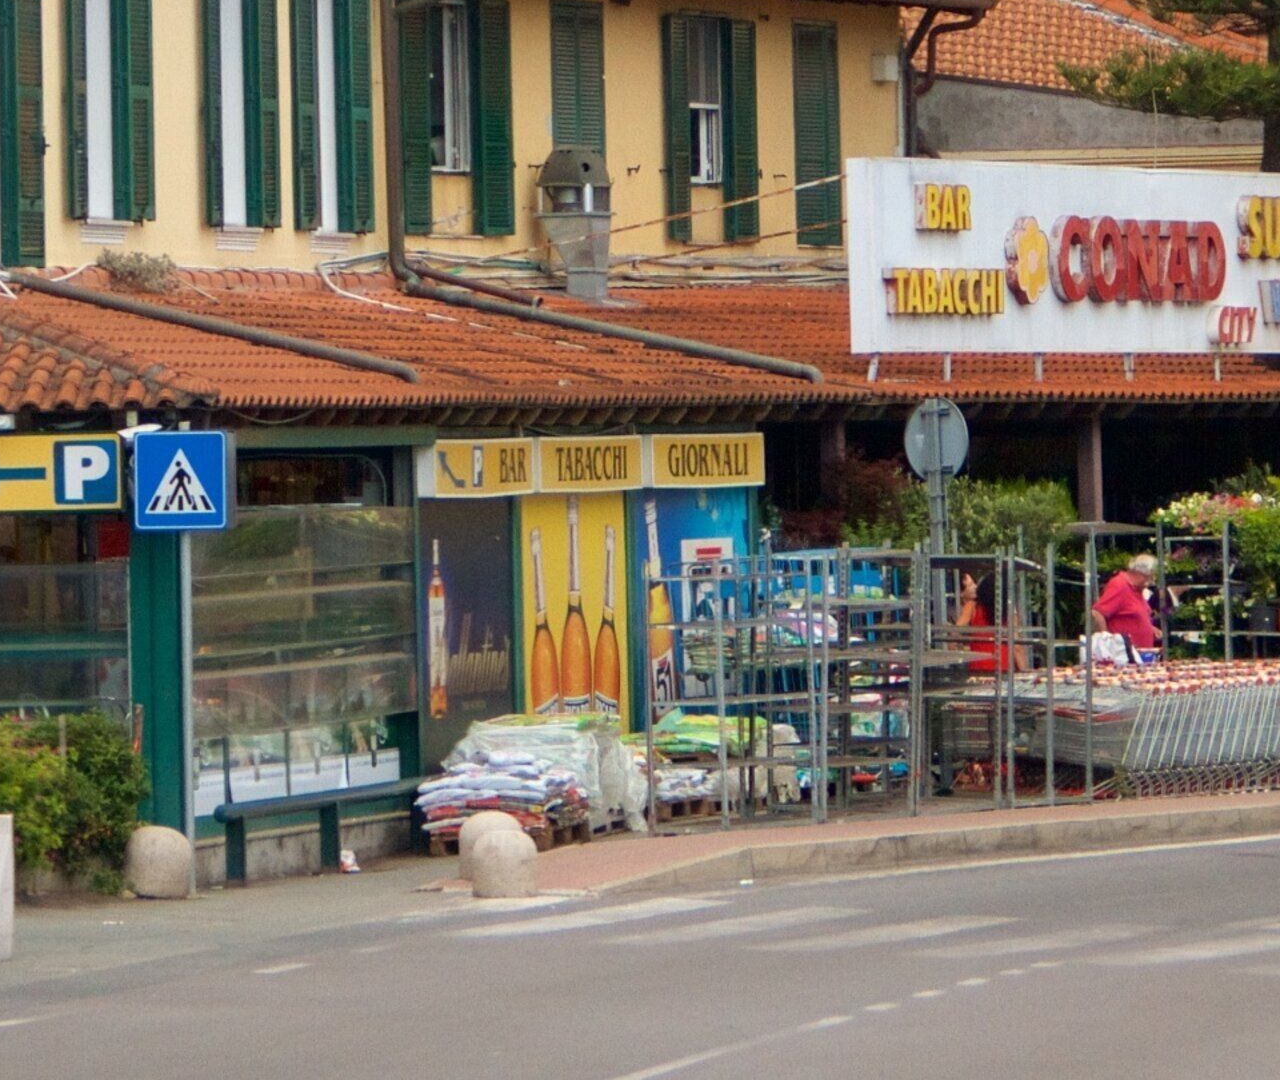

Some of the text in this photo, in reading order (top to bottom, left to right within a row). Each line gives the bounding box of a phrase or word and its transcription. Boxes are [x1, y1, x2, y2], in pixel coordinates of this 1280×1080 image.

[923, 183, 972, 231] BAR
[1055, 214, 1227, 303] CONAD
[890, 267, 1005, 315] TABACCHI
[1218, 306, 1258, 344] CITY
[499, 447, 528, 484] BAR
[556, 445, 628, 483] TABACCHI
[668, 443, 750, 478] GIORNALI
